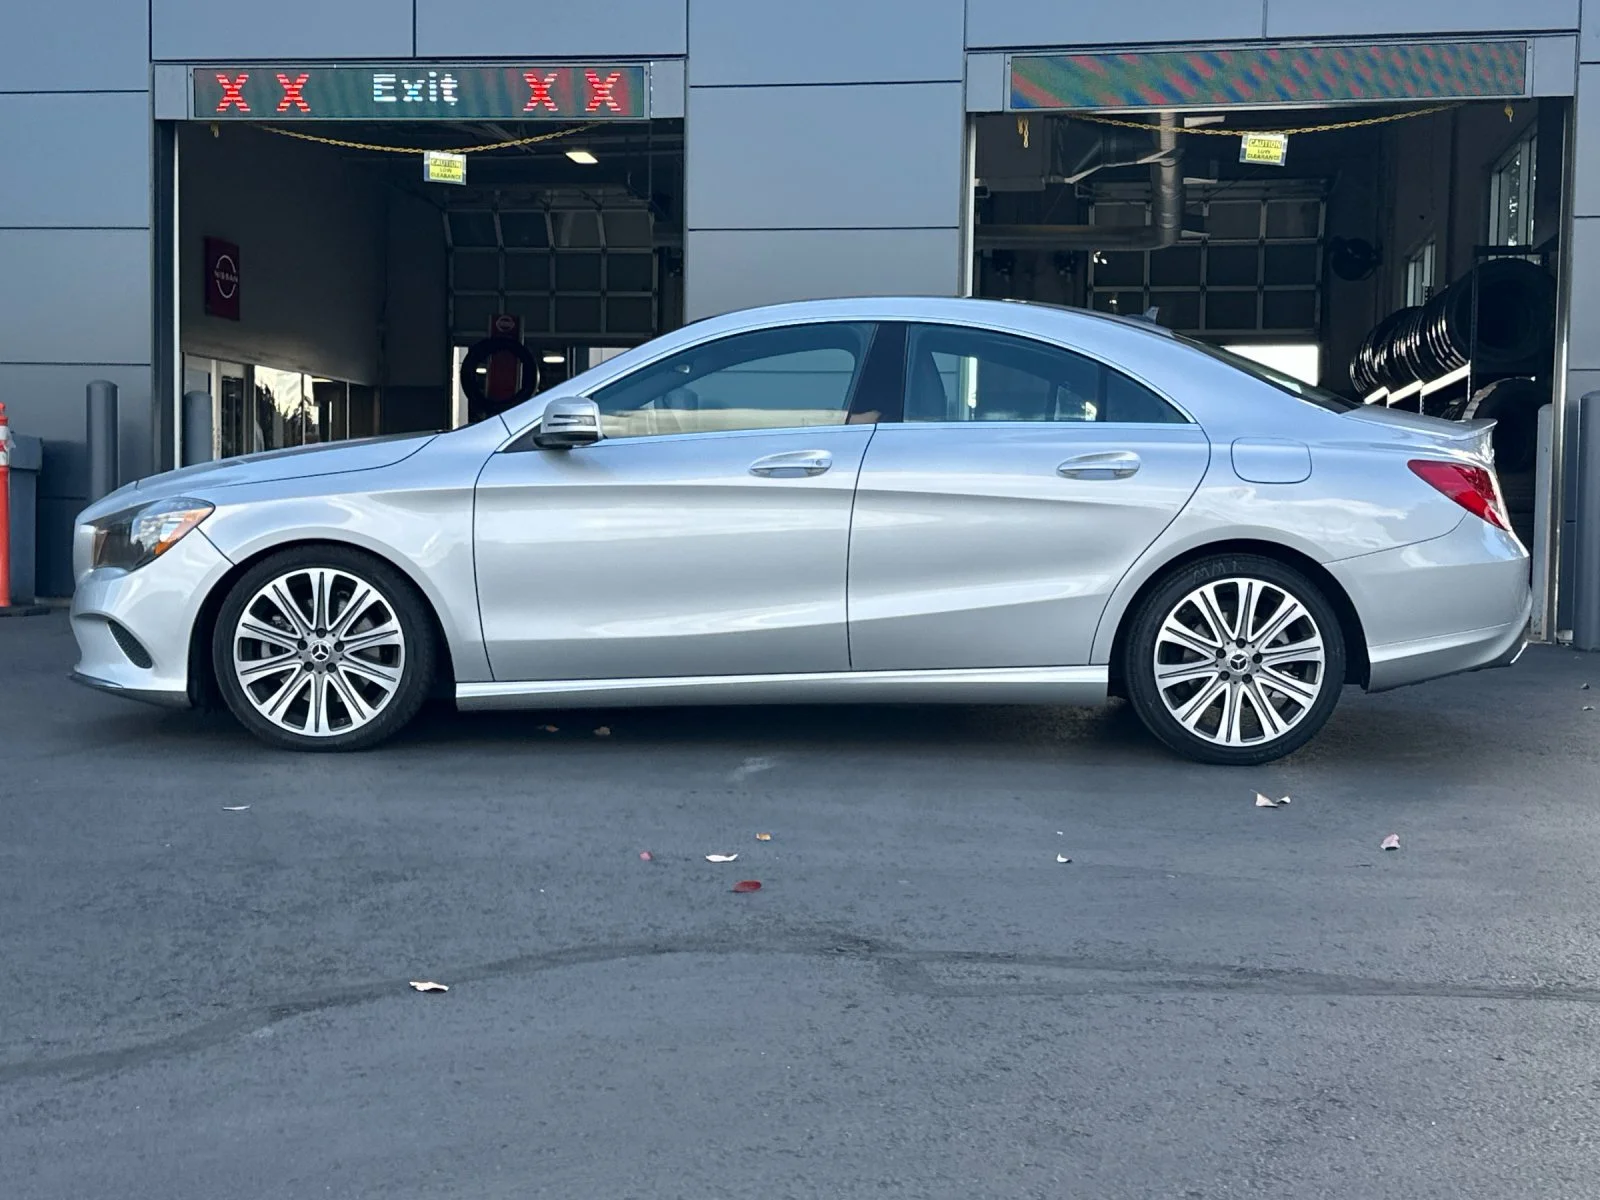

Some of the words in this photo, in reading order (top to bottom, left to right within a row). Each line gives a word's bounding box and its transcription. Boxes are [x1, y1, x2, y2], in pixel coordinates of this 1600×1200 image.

[216, 73, 251, 112] X
[276, 73, 311, 112] X
[373, 71, 459, 105] Exit
[523, 72, 558, 112] X
[585, 72, 623, 112] X
[1249, 139, 1282, 149] CAUTION
[1247, 153, 1280, 161] CLEARANCE
[431, 158, 462, 168] CAUTION
[430, 172, 461, 180] CLEARANCE
[214, 269, 238, 283] NISSAN
